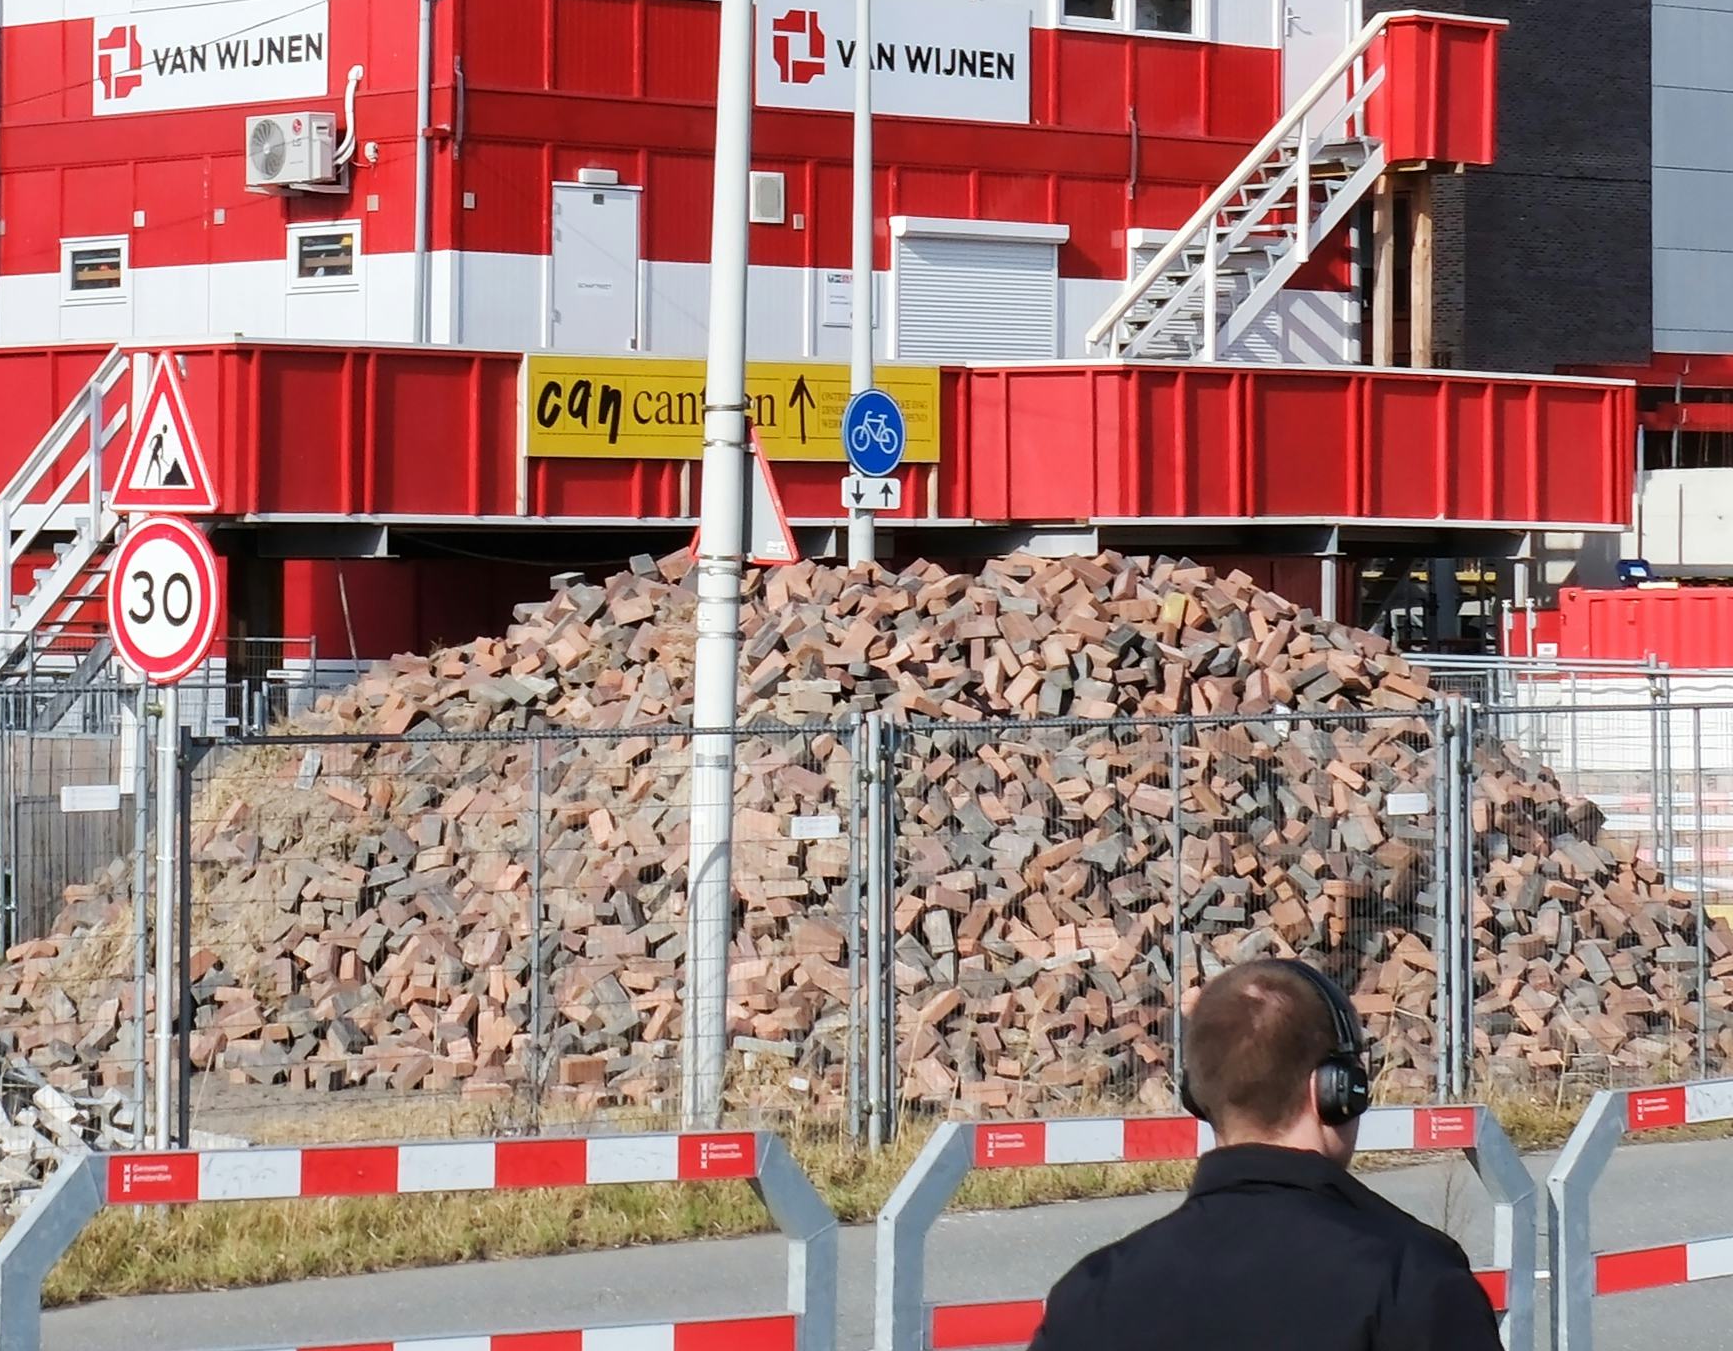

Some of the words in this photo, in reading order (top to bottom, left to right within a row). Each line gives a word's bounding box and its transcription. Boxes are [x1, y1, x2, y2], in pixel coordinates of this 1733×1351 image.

[153, 44, 207, 76] VAN
[216, 32, 323, 70] WIJNEN
[904, 45, 1015, 80] WIJNEN
[536, 379, 622, 445] can
[128, 570, 192, 627] 30
